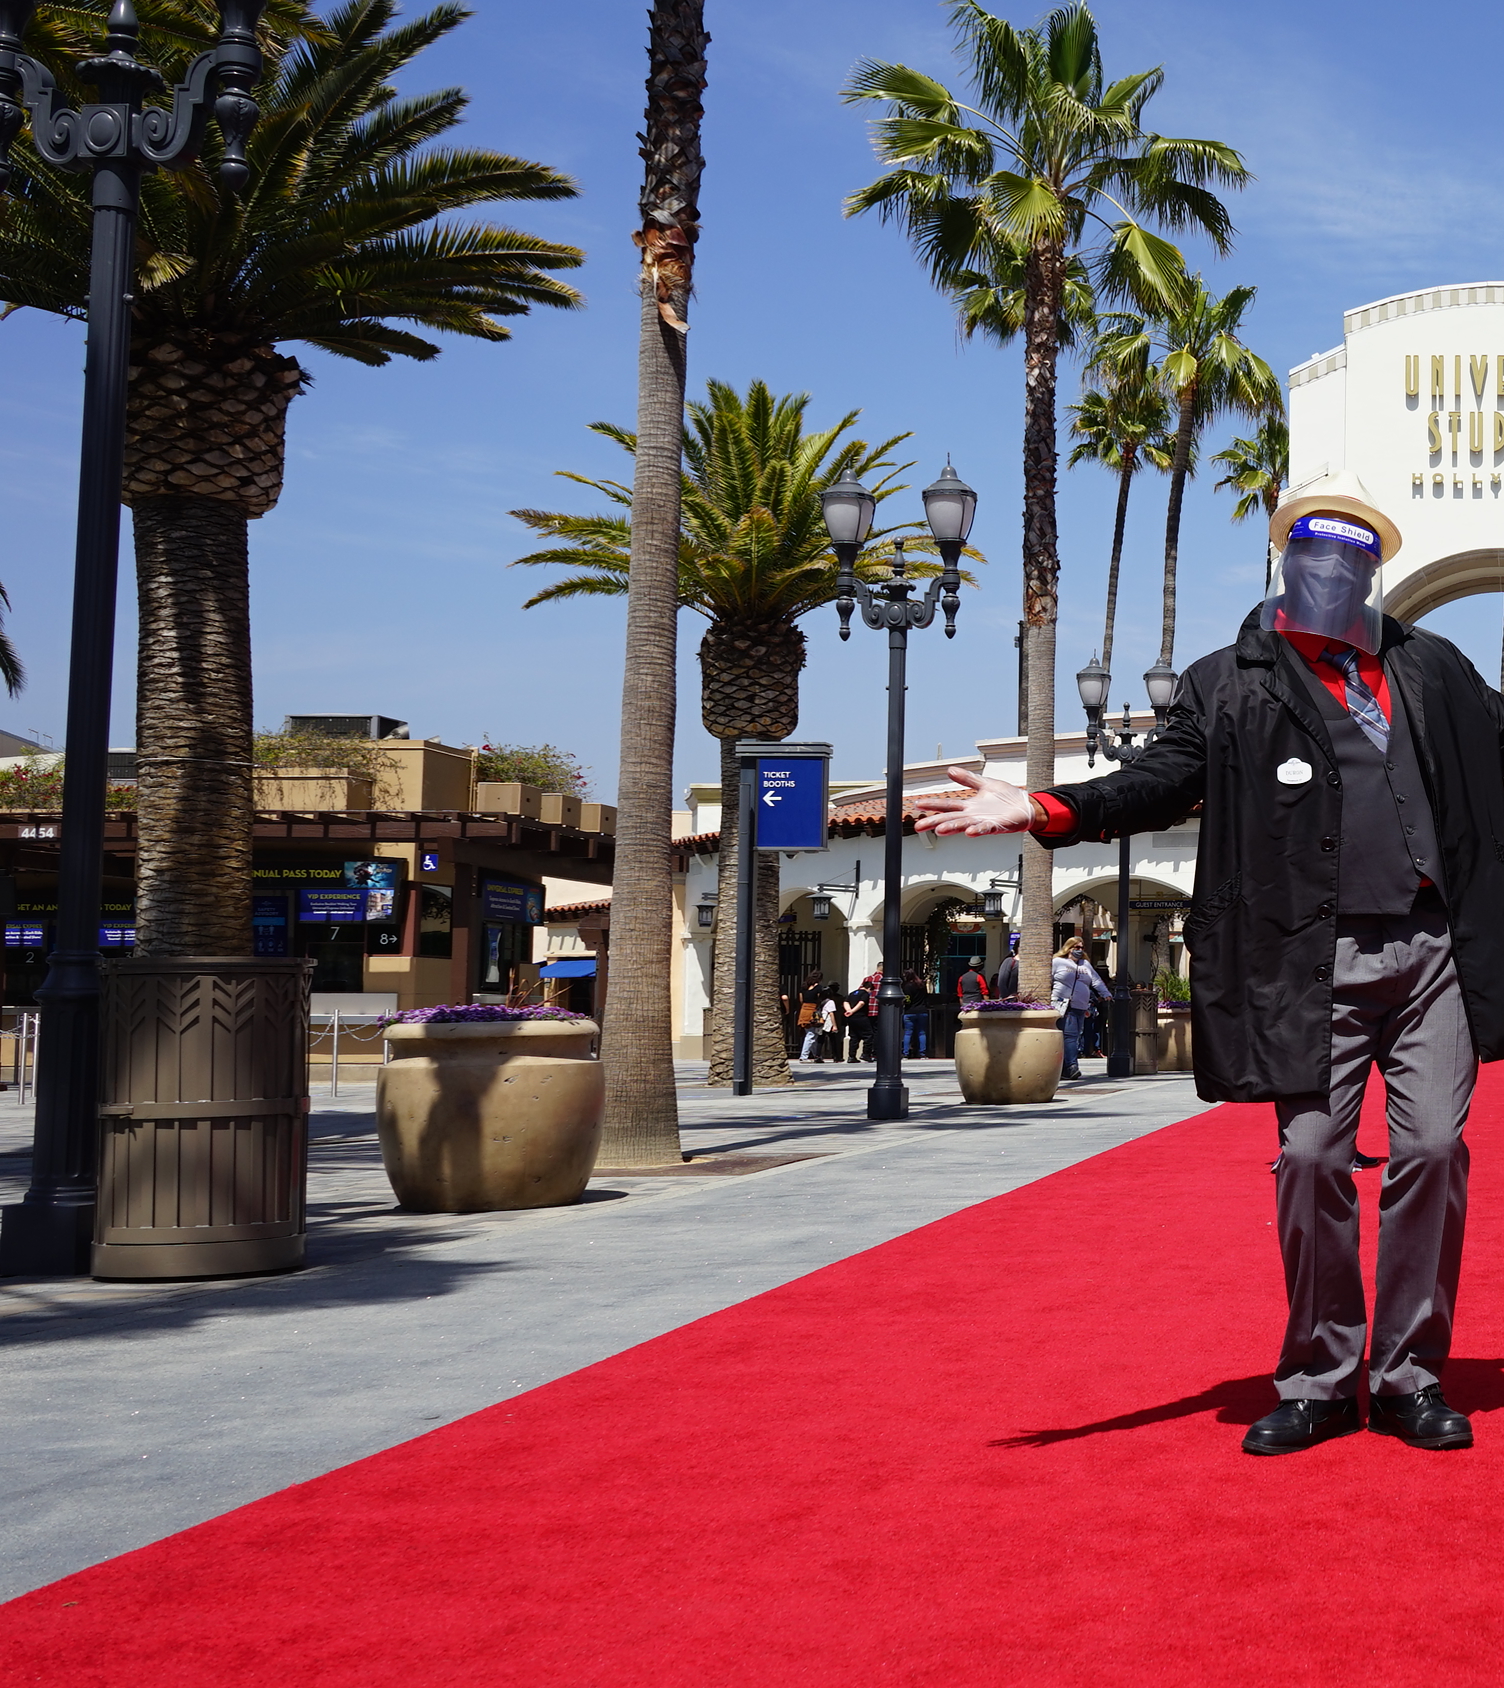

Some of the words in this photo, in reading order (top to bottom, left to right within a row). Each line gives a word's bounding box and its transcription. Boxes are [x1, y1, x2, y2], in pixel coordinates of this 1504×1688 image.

[1314, 521, 1336, 531] Face
[1340, 526, 1370, 542] Shield
[763, 771, 792, 779] TICKET
[763, 780, 796, 788] BOOTHS
[20, 827, 55, 839] 4454
[252, 869, 281, 878] NUAL
[282, 869, 308, 878] PASS
[308, 869, 343, 878] TODAY
[32, 903, 45, 911] AN
[104, 903, 133, 911] TODAY
[330, 926, 340, 940] 7
[379, 933, 389, 944] 8
[25, 951, 35, 963] 2
